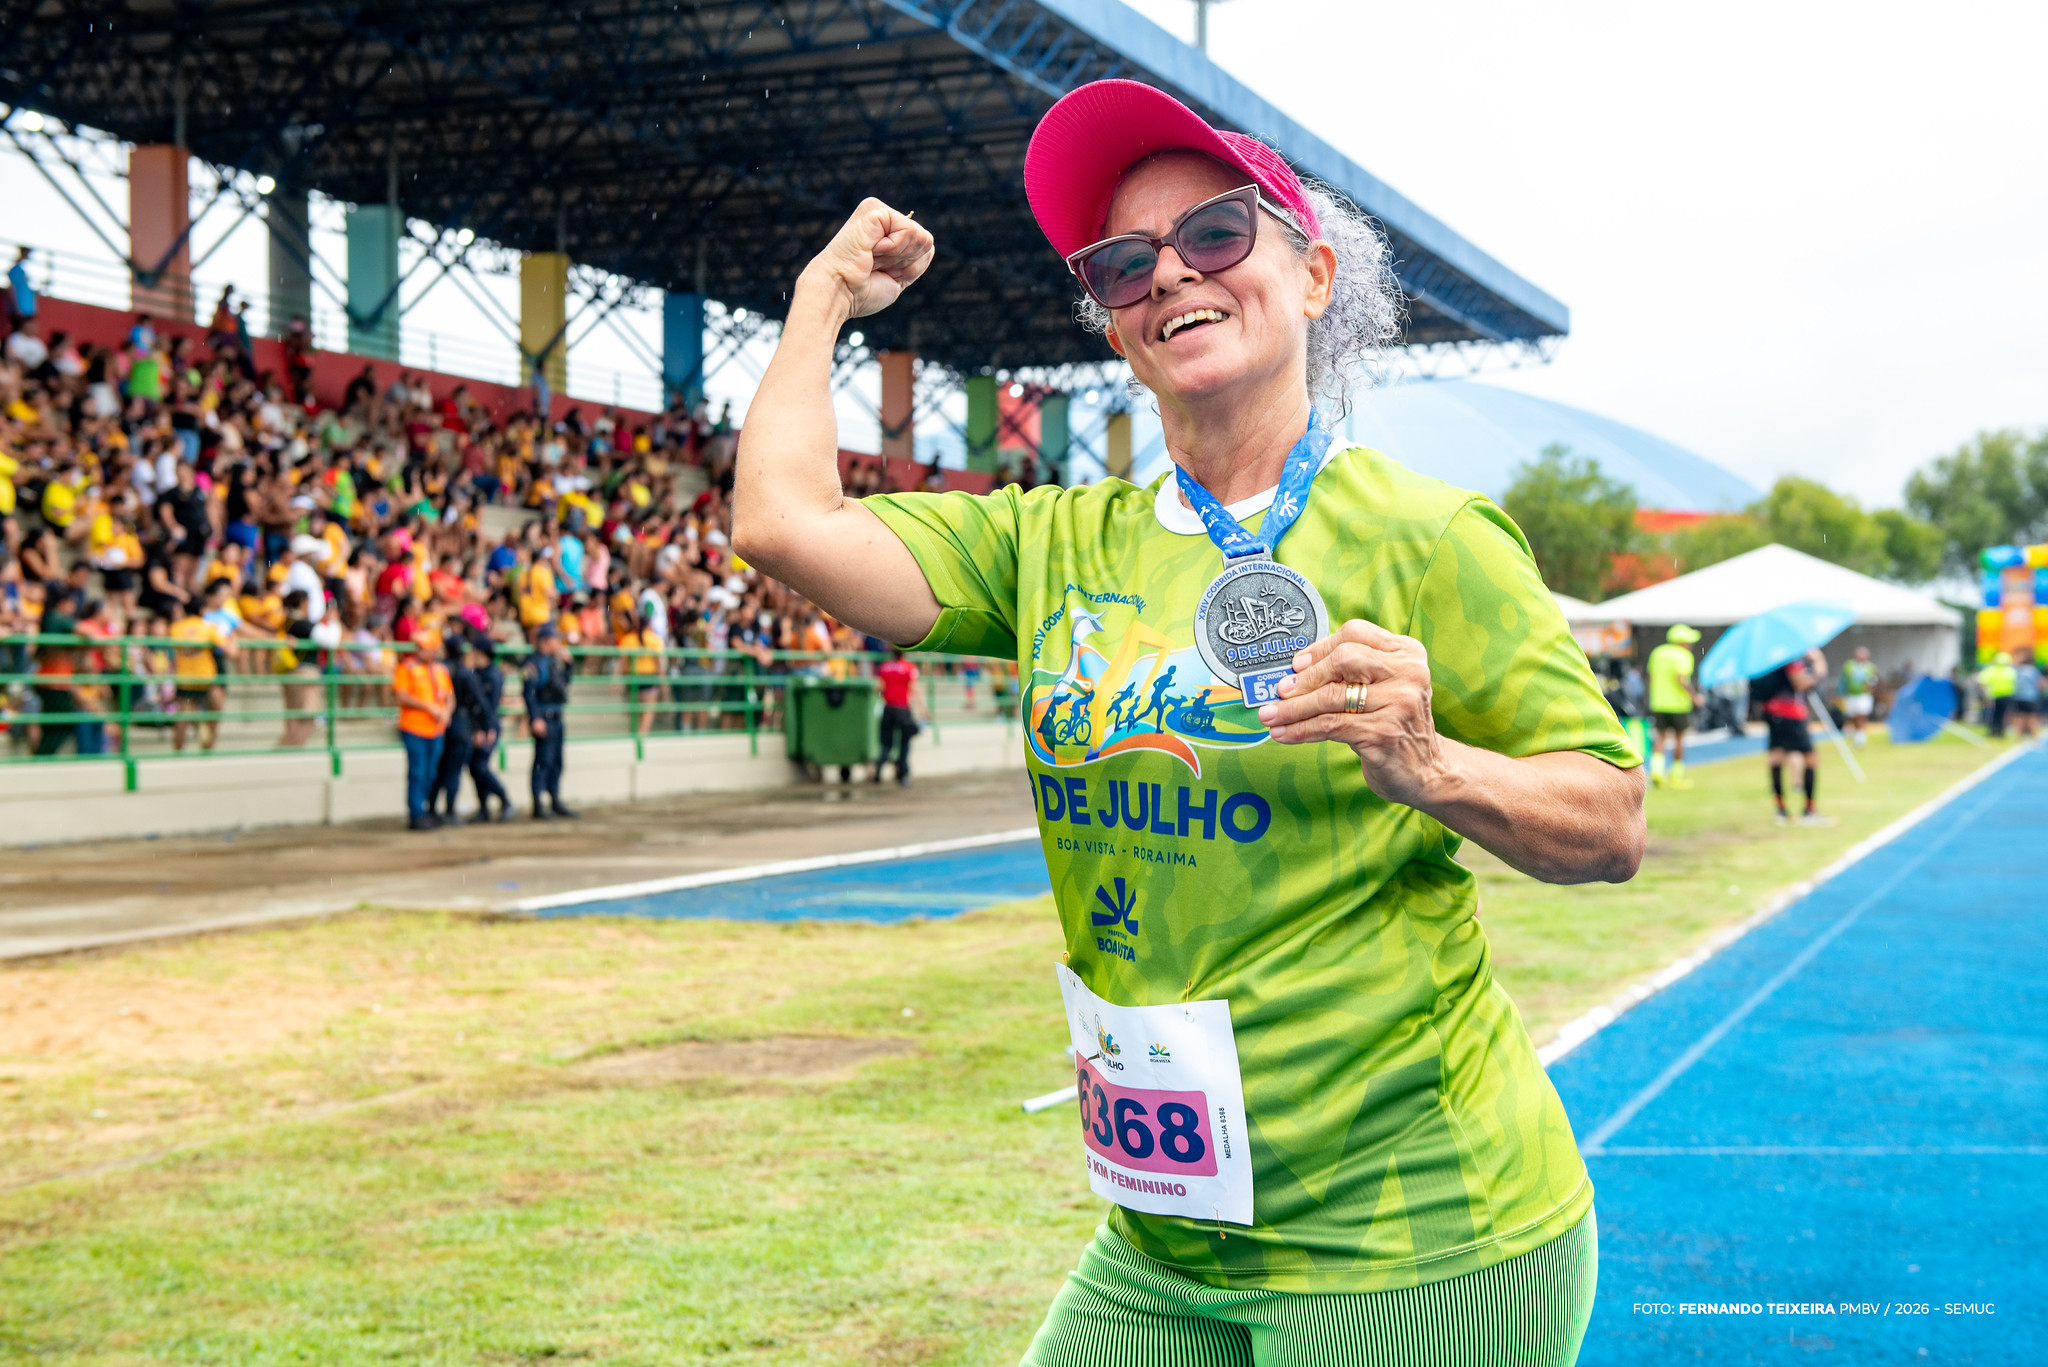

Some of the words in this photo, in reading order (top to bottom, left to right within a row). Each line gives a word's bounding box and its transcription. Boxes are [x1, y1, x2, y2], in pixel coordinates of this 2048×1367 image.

[1198, 596, 1209, 621] XXIV
[1206, 570, 1238, 598] CORRIDA
[1238, 563, 1306, 588] INTERNACIONAL
[1032, 628, 1046, 660] XXIV
[1226, 649, 1237, 662] 9
[1238, 645, 1259, 660] DE
[1260, 636, 1308, 656] JULHO
[1249, 658, 1265, 666] VISTA
[1257, 671, 1288, 681] CORRIDA
[1253, 681, 1279, 701] 5K
[1038, 773, 1091, 825] DE
[1098, 779, 1271, 843] JULHO
[1057, 837, 1080, 852] BOA
[1085, 840, 1116, 857] VISTA
[1133, 846, 1197, 867] RORAIMA
[1078, 1068, 1205, 1163] 6368
[1219, 1107, 1227, 1123] 6368
[1221, 1125, 1232, 1159] MEDALHA
[1086, 1154, 1092, 1169] 5
[1093, 1159, 1109, 1180] KM
[1110, 1170, 1187, 1197] FEMININO
